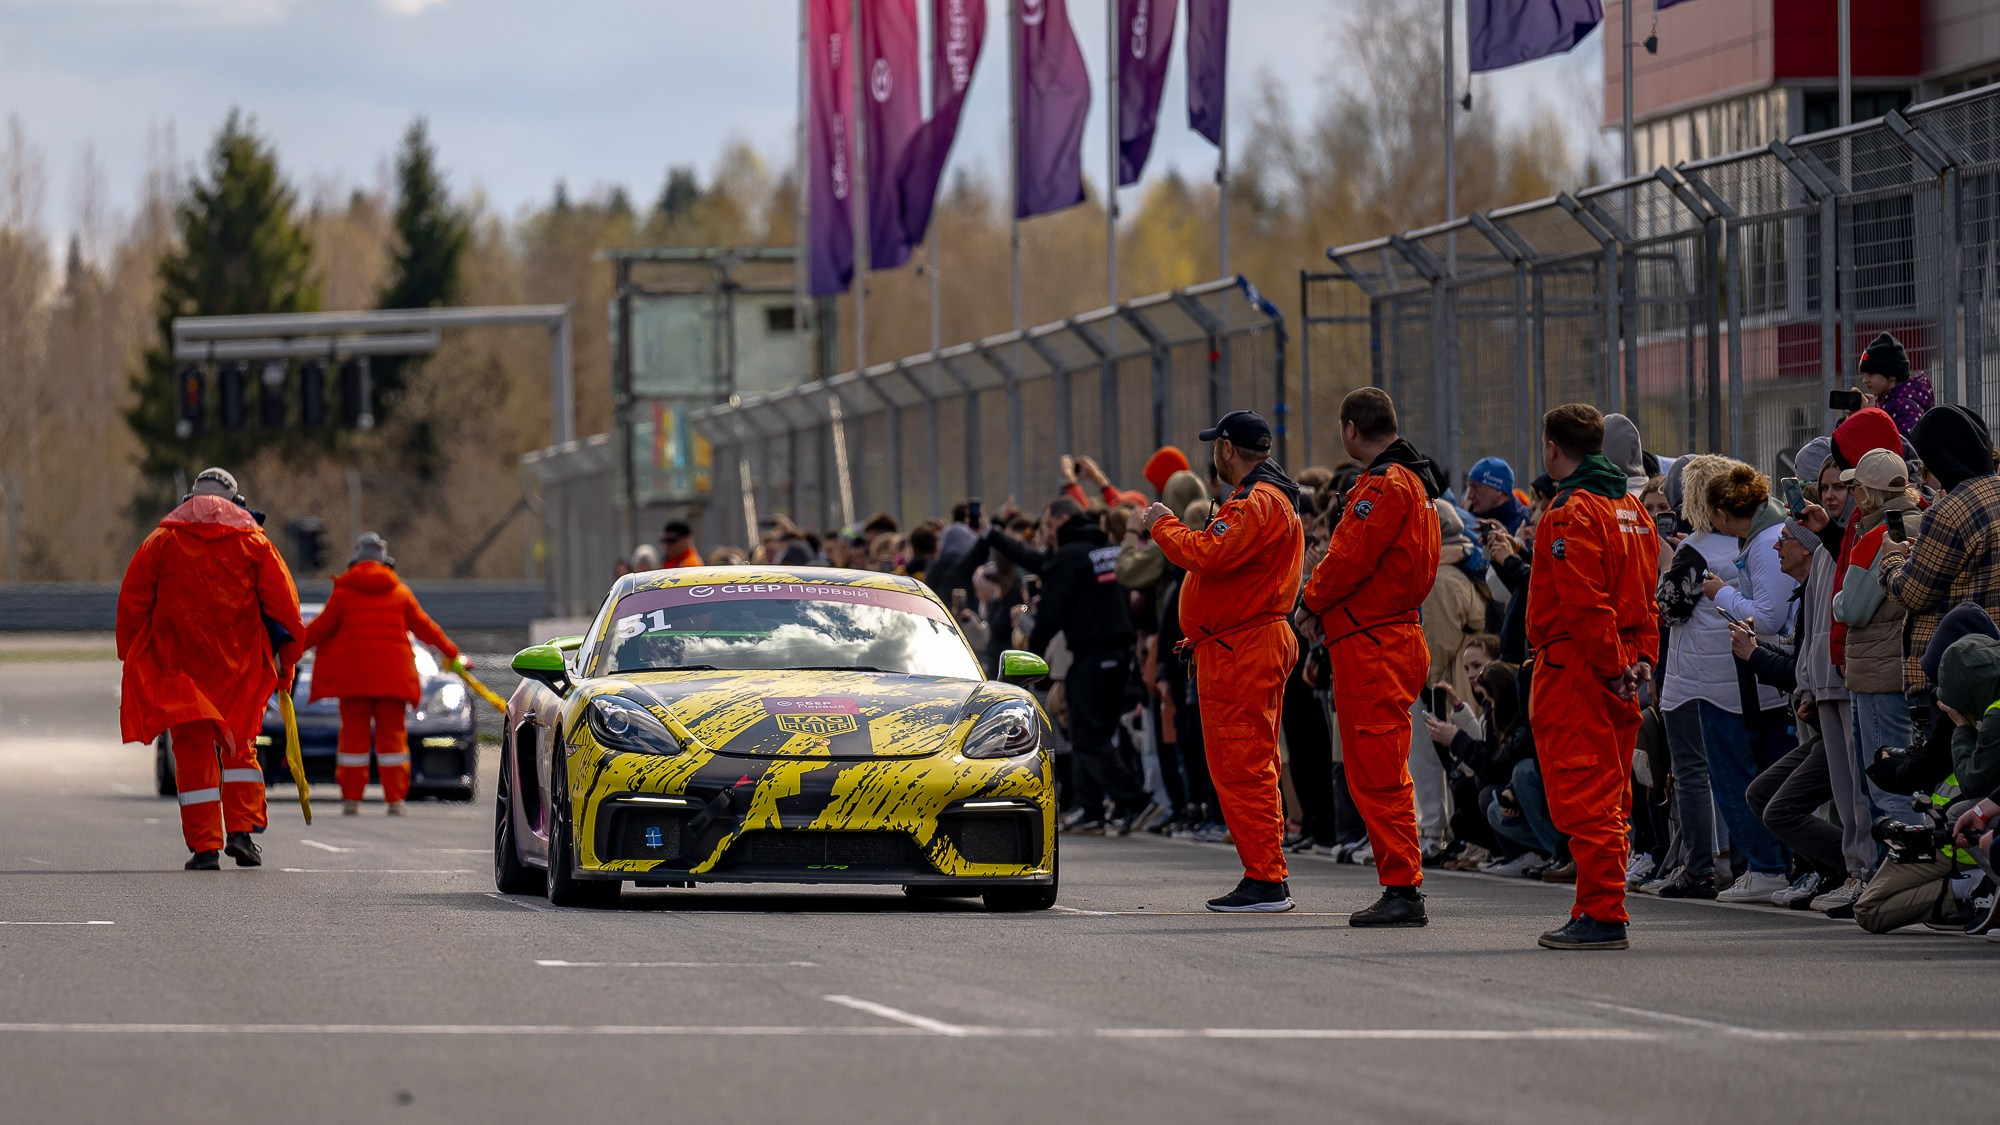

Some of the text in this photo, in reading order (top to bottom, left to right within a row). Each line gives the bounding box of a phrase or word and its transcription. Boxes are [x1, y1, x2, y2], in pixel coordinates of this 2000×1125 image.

[721, 584, 869, 598] СБЕР Первый
[618, 609, 671, 639] 51
[787, 724, 849, 734] HEUER
